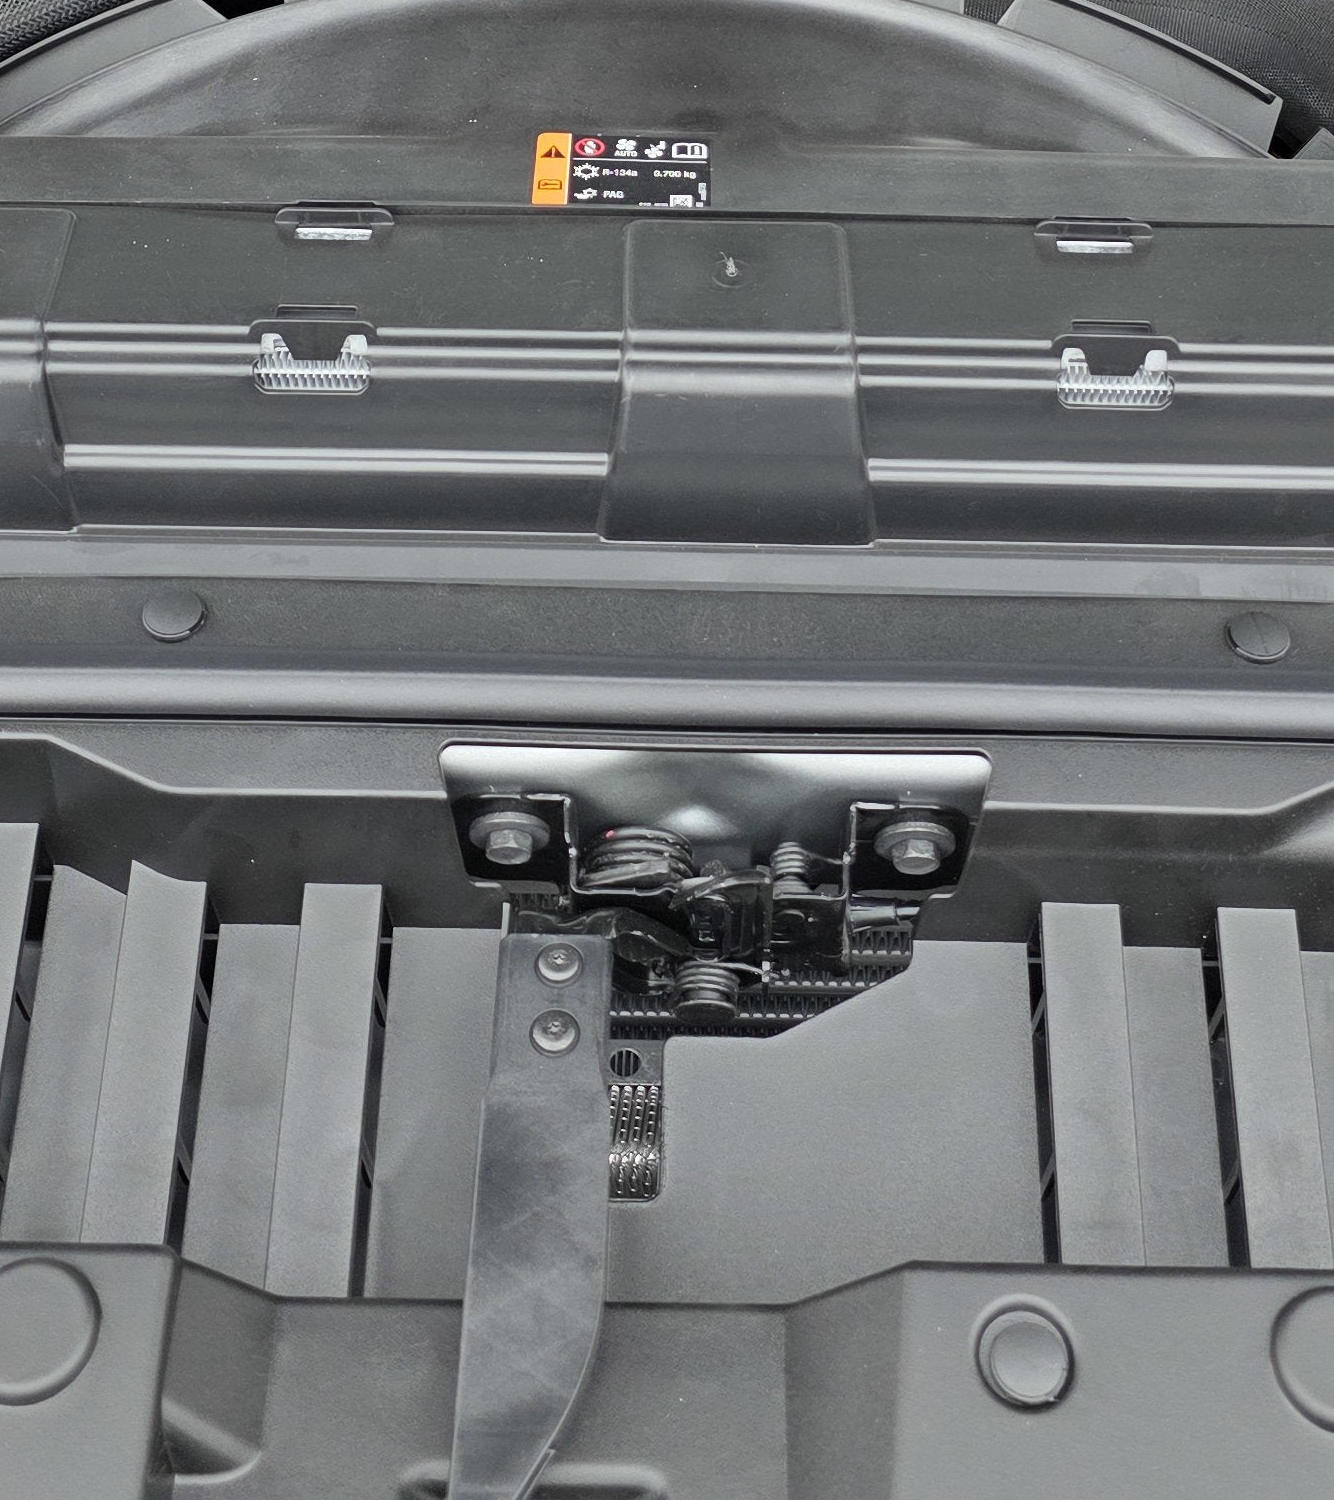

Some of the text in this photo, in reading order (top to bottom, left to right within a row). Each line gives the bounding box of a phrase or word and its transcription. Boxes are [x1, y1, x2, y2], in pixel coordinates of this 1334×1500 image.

[602, 168, 638, 177] R-134a
[683, 170, 697, 180] kg
[603, 190, 625, 199] PAG
